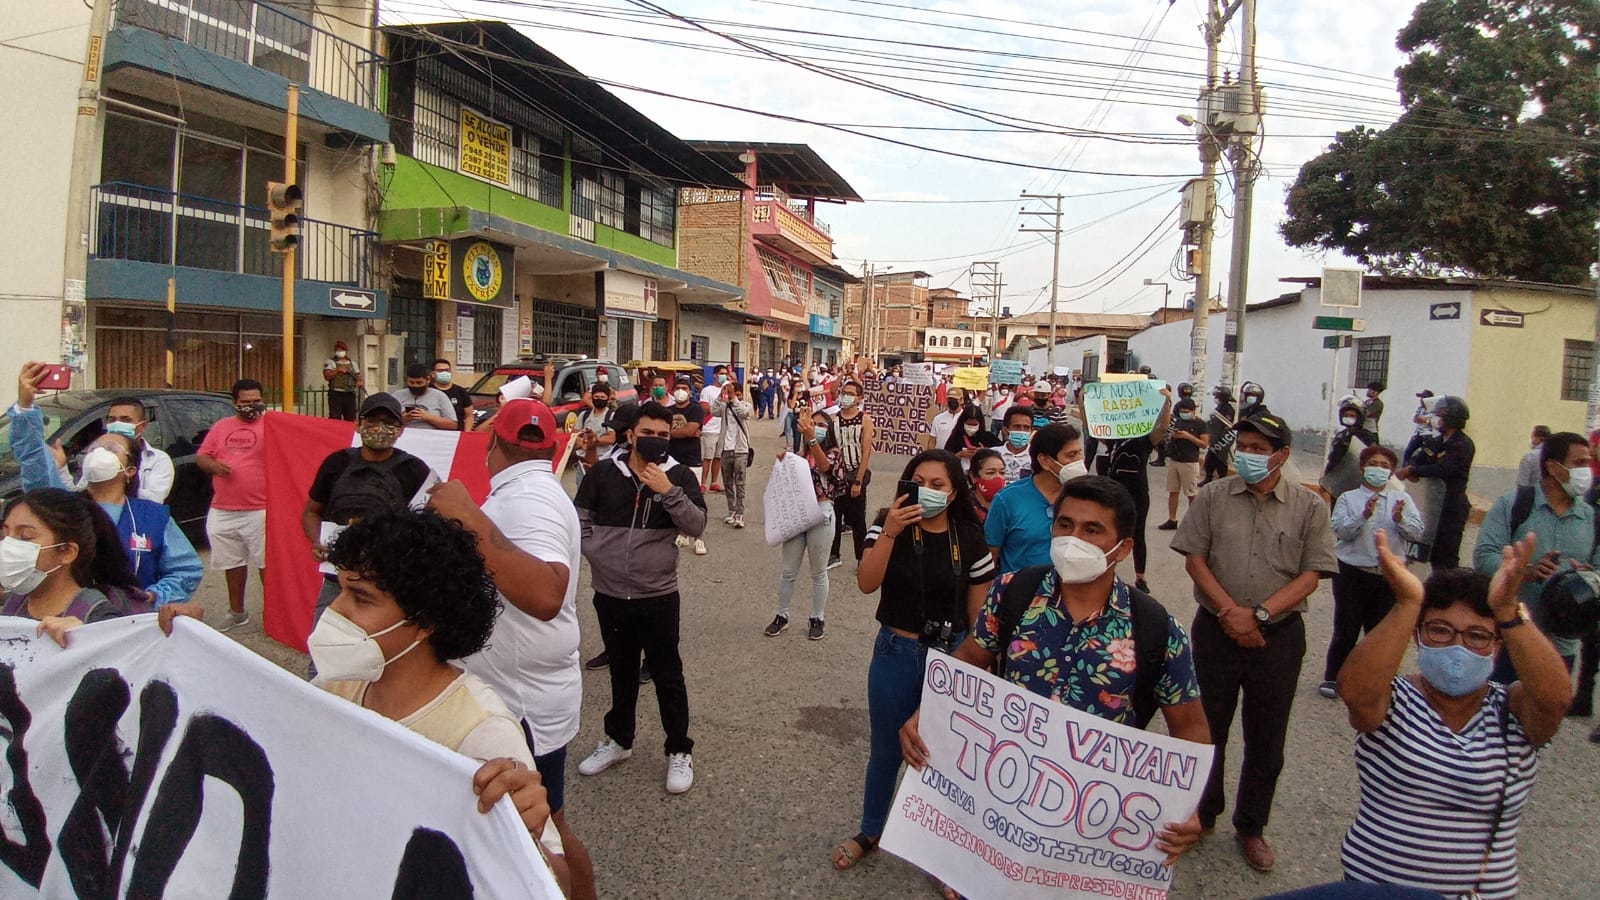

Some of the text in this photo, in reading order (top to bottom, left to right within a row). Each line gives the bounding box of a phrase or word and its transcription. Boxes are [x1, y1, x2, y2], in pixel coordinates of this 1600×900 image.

[464, 114, 508, 142] SE ALQUILA
[468, 131, 506, 155] O VENDE
[425, 256, 433, 296] GYM
[434, 244, 448, 297] GYM
[887, 382, 912, 394] QUE
[916, 385, 932, 396] LA
[909, 409, 926, 420] DE
[919, 397, 930, 408] ES
[1103, 398, 1142, 412] RABIA
[1091, 424, 1112, 437] VOTO
[928, 658, 1197, 790] QUE SE VAYAN
[950, 710, 1161, 851] TODOS
[922, 765, 1172, 881] NUEVA CONSTITUCION
